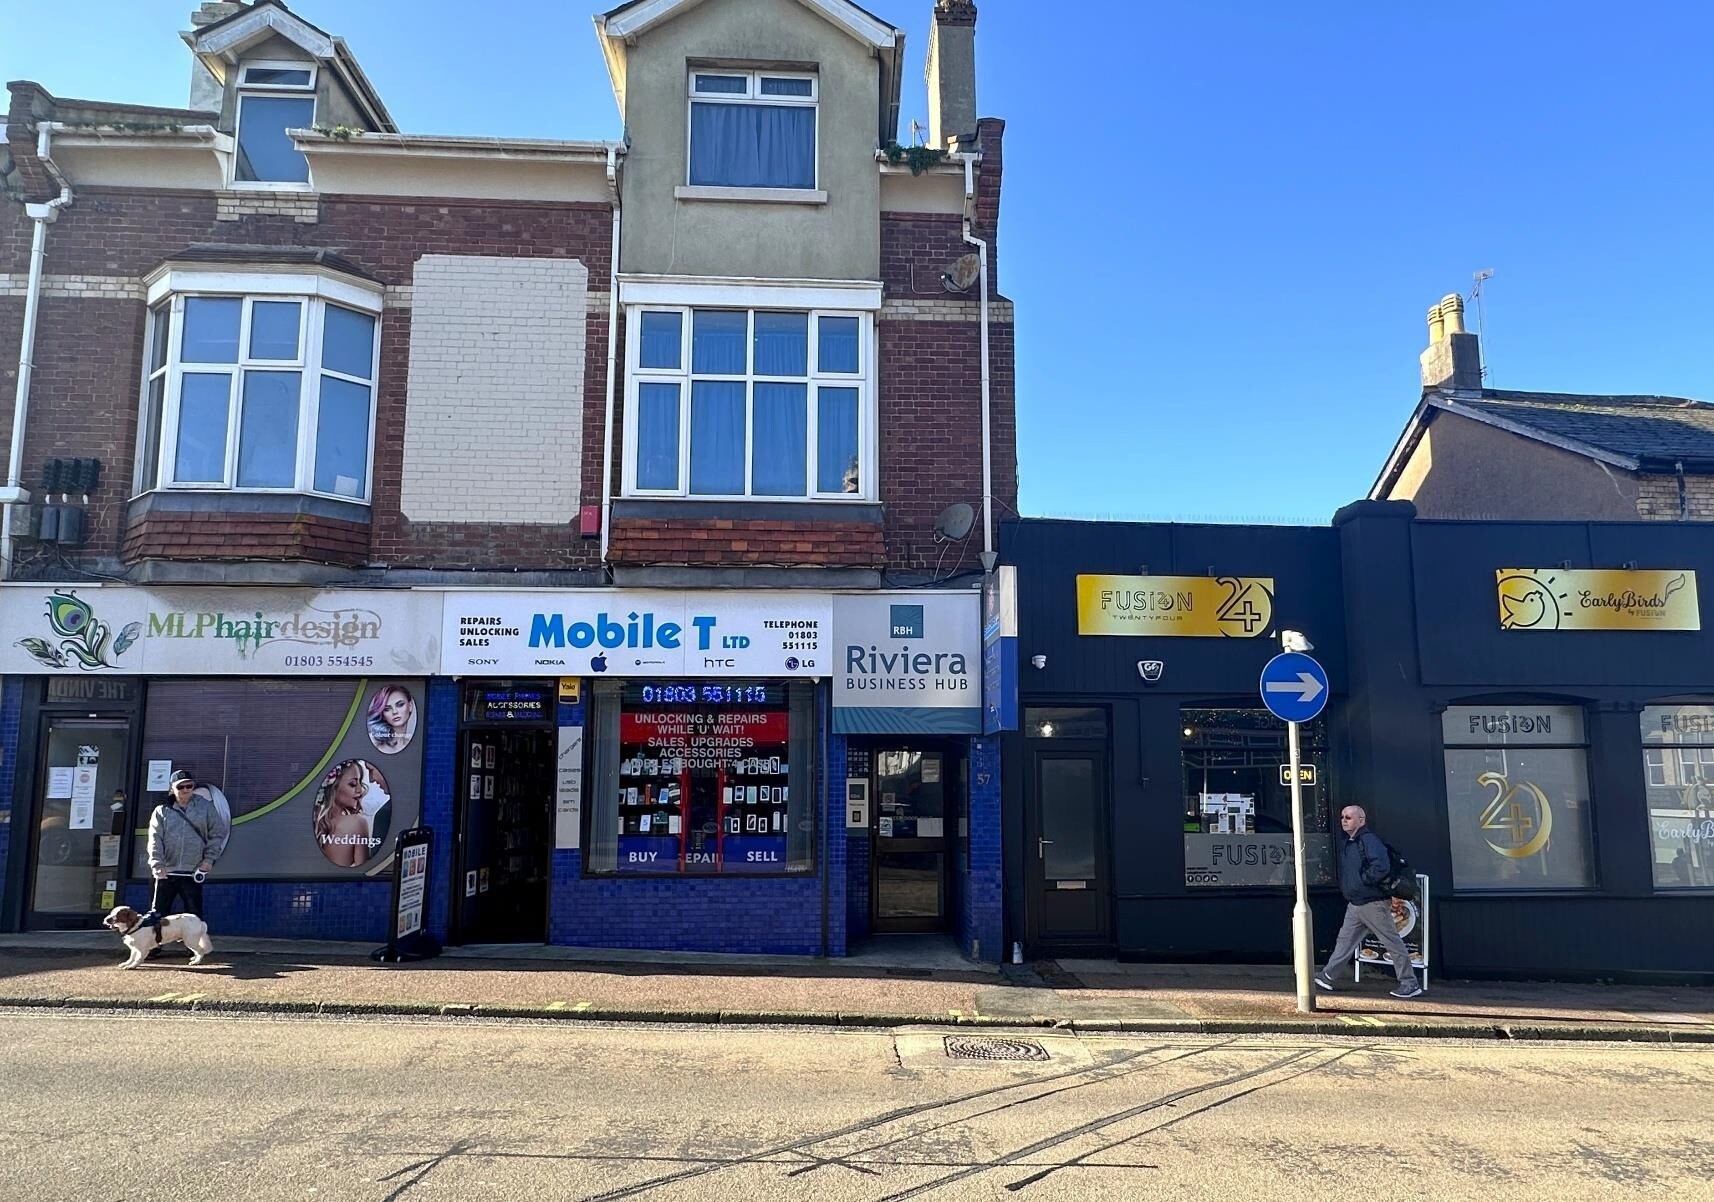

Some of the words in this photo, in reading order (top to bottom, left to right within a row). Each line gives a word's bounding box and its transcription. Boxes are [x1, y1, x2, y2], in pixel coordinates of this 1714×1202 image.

[1101, 591, 1193, 611] FUSION
[1215, 577, 1262, 633] 24
[460, 617, 502, 625] REPAIRS
[763, 621, 818, 629] TELEPHONE
[460, 627, 520, 636] UNLOCKING
[528, 612, 682, 649] Mobile
[692, 616, 717, 650] T
[722, 635, 751, 649] LTD
[788, 631, 818, 639] 01803
[893, 626, 913, 635] RBH
[459, 638, 490, 646] SALES
[782, 642, 818, 650] 551115
[285, 655, 323, 667] 01803
[327, 655, 373, 667] 554545
[468, 658, 500, 666] SONY
[802, 659, 816, 668] LG
[846, 645, 967, 675] Riviera
[846, 678, 926, 690] BUSINESS
[935, 678, 968, 690] HUB
[642, 686, 696, 702] 01803
[702, 686, 766, 702] 551115
[635, 714, 704, 724] UNLOCKING
[706, 714, 713, 724] &
[718, 714, 768, 724] REPAIRS
[1469, 715, 1551, 734] FUSION
[657, 725, 694, 735] WHILE
[713, 725, 745, 735] WAIT!
[648, 737, 688, 748] SALES,
[691, 737, 754, 747] UPGRADES
[659, 748, 742, 758] ACCESSORIES
[977, 773, 990, 784] 57
[1284, 770, 1312, 780] OEN
[1476, 771, 1532, 842] 24
[321, 833, 381, 848] Weddings
[629, 852, 658, 862] BUY
[746, 851, 778, 862] SELL
[1212, 845, 1294, 865] FUSIO
